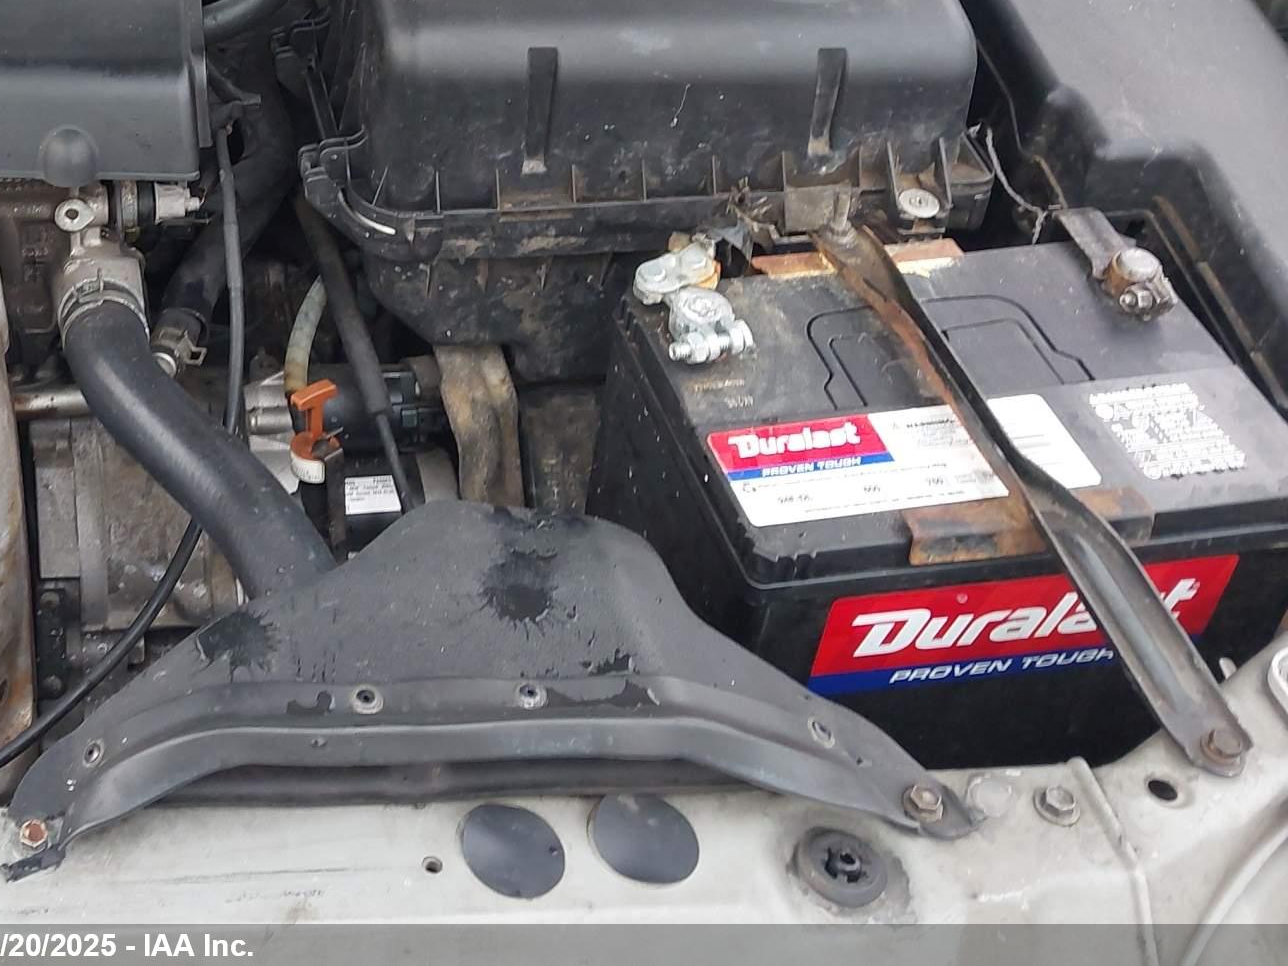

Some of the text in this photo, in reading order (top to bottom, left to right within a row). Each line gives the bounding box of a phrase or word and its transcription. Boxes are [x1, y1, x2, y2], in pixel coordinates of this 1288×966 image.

[727, 421, 861, 459] Duralast
[761, 461, 815, 478] PROVEN
[817, 456, 862, 471] TOUGH
[851, 577, 1201, 658] Duralat
[889, 647, 1114, 684] PROVEN TOUGH
